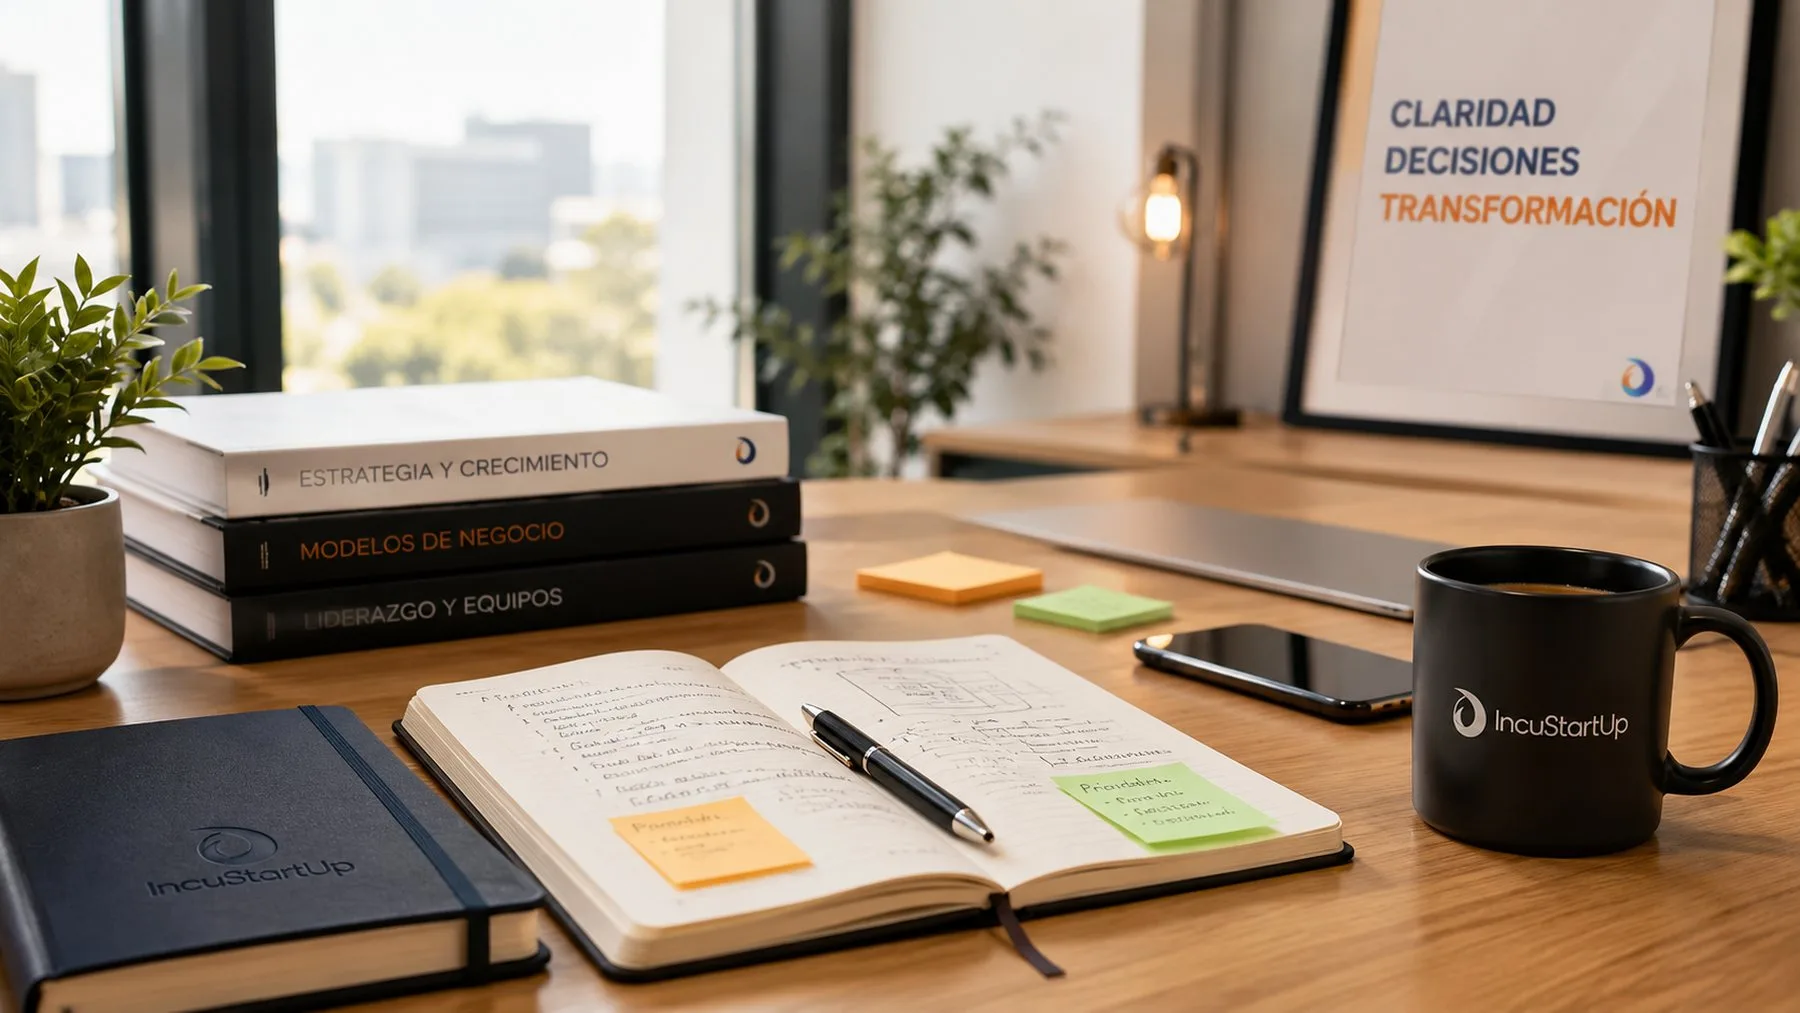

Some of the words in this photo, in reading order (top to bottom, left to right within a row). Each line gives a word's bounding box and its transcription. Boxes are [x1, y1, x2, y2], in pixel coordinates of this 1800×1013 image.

[1391, 98, 1556, 128] CLARIDAD
[1385, 146, 1580, 176] DECISIONES
[1380, 189, 1677, 228] TRANSFORMACIÓN
[300, 463, 434, 488] ESTRATEGIA
[440, 461, 453, 478] Y
[460, 451, 609, 477] CRECIMIENTO
[301, 534, 415, 560] MODELOS
[423, 531, 452, 551] DE
[460, 521, 565, 547] NEGOCIO
[304, 600, 436, 630] LIDERAZGO
[443, 598, 457, 616] Y
[464, 588, 563, 614] EQUIPOS
[1495, 709, 1629, 740] IncuStartUp
[147, 860, 356, 896] IncuStartUp
